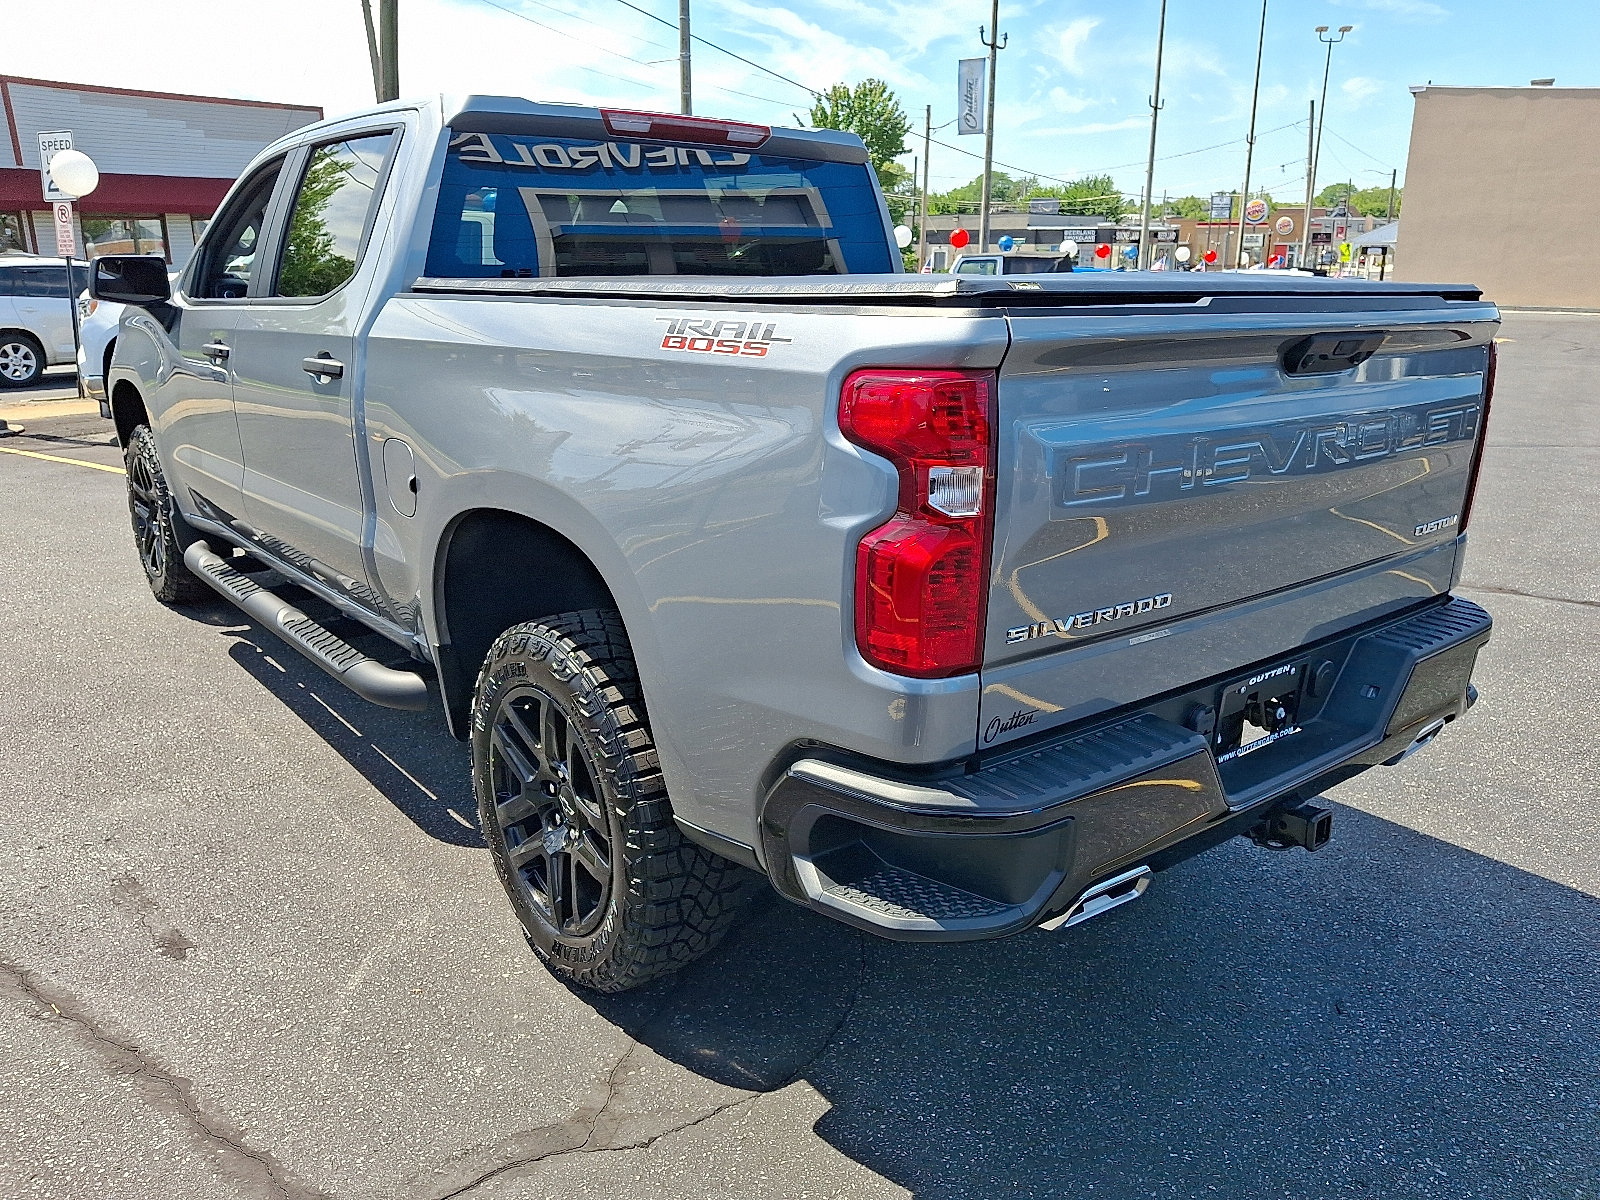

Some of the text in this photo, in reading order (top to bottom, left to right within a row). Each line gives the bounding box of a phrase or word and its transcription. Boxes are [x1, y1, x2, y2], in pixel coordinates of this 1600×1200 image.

[41, 139, 71, 151] SPEED
[655, 317, 792, 343] TRAIL
[661, 335, 771, 357] BOSS
[1414, 514, 1458, 537] CUSTOM
[1006, 592, 1173, 645] SILVERADO
[1248, 664, 1291, 686] OUTTEN
[983, 709, 1040, 744] Outten
